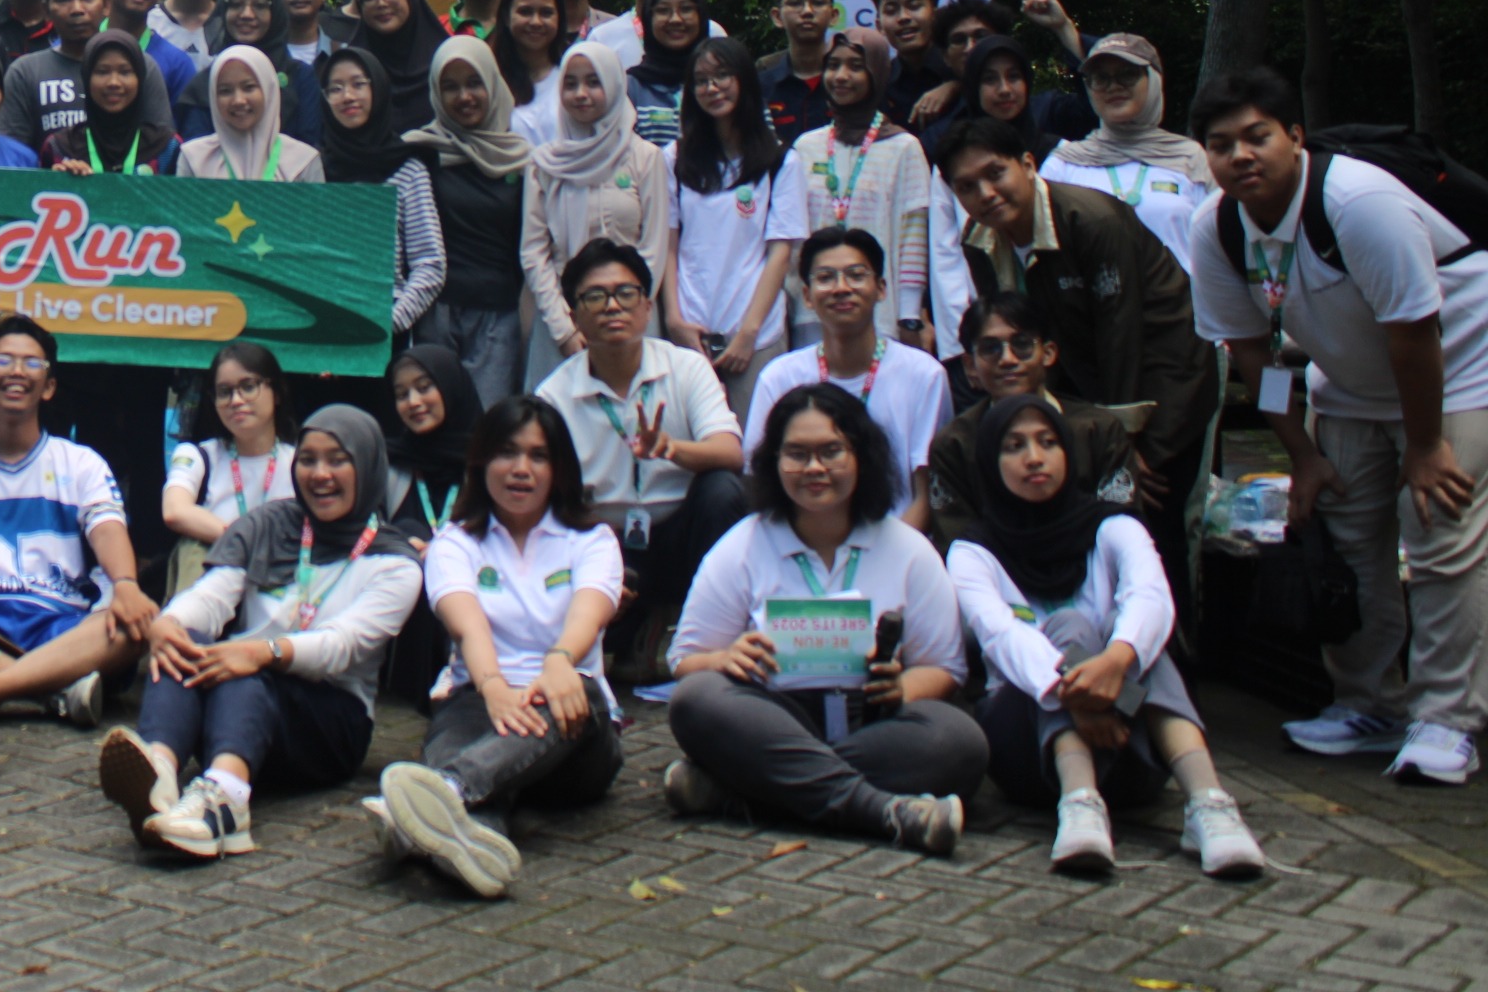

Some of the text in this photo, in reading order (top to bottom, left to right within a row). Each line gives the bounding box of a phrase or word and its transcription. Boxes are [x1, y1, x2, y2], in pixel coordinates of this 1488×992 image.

[39, 79, 76, 105] ITS
[15, 290, 82, 321] Live
[91, 294, 218, 327] Cleaner
[772, 618, 807, 631] 2025
[812, 618, 836, 631] ITS
